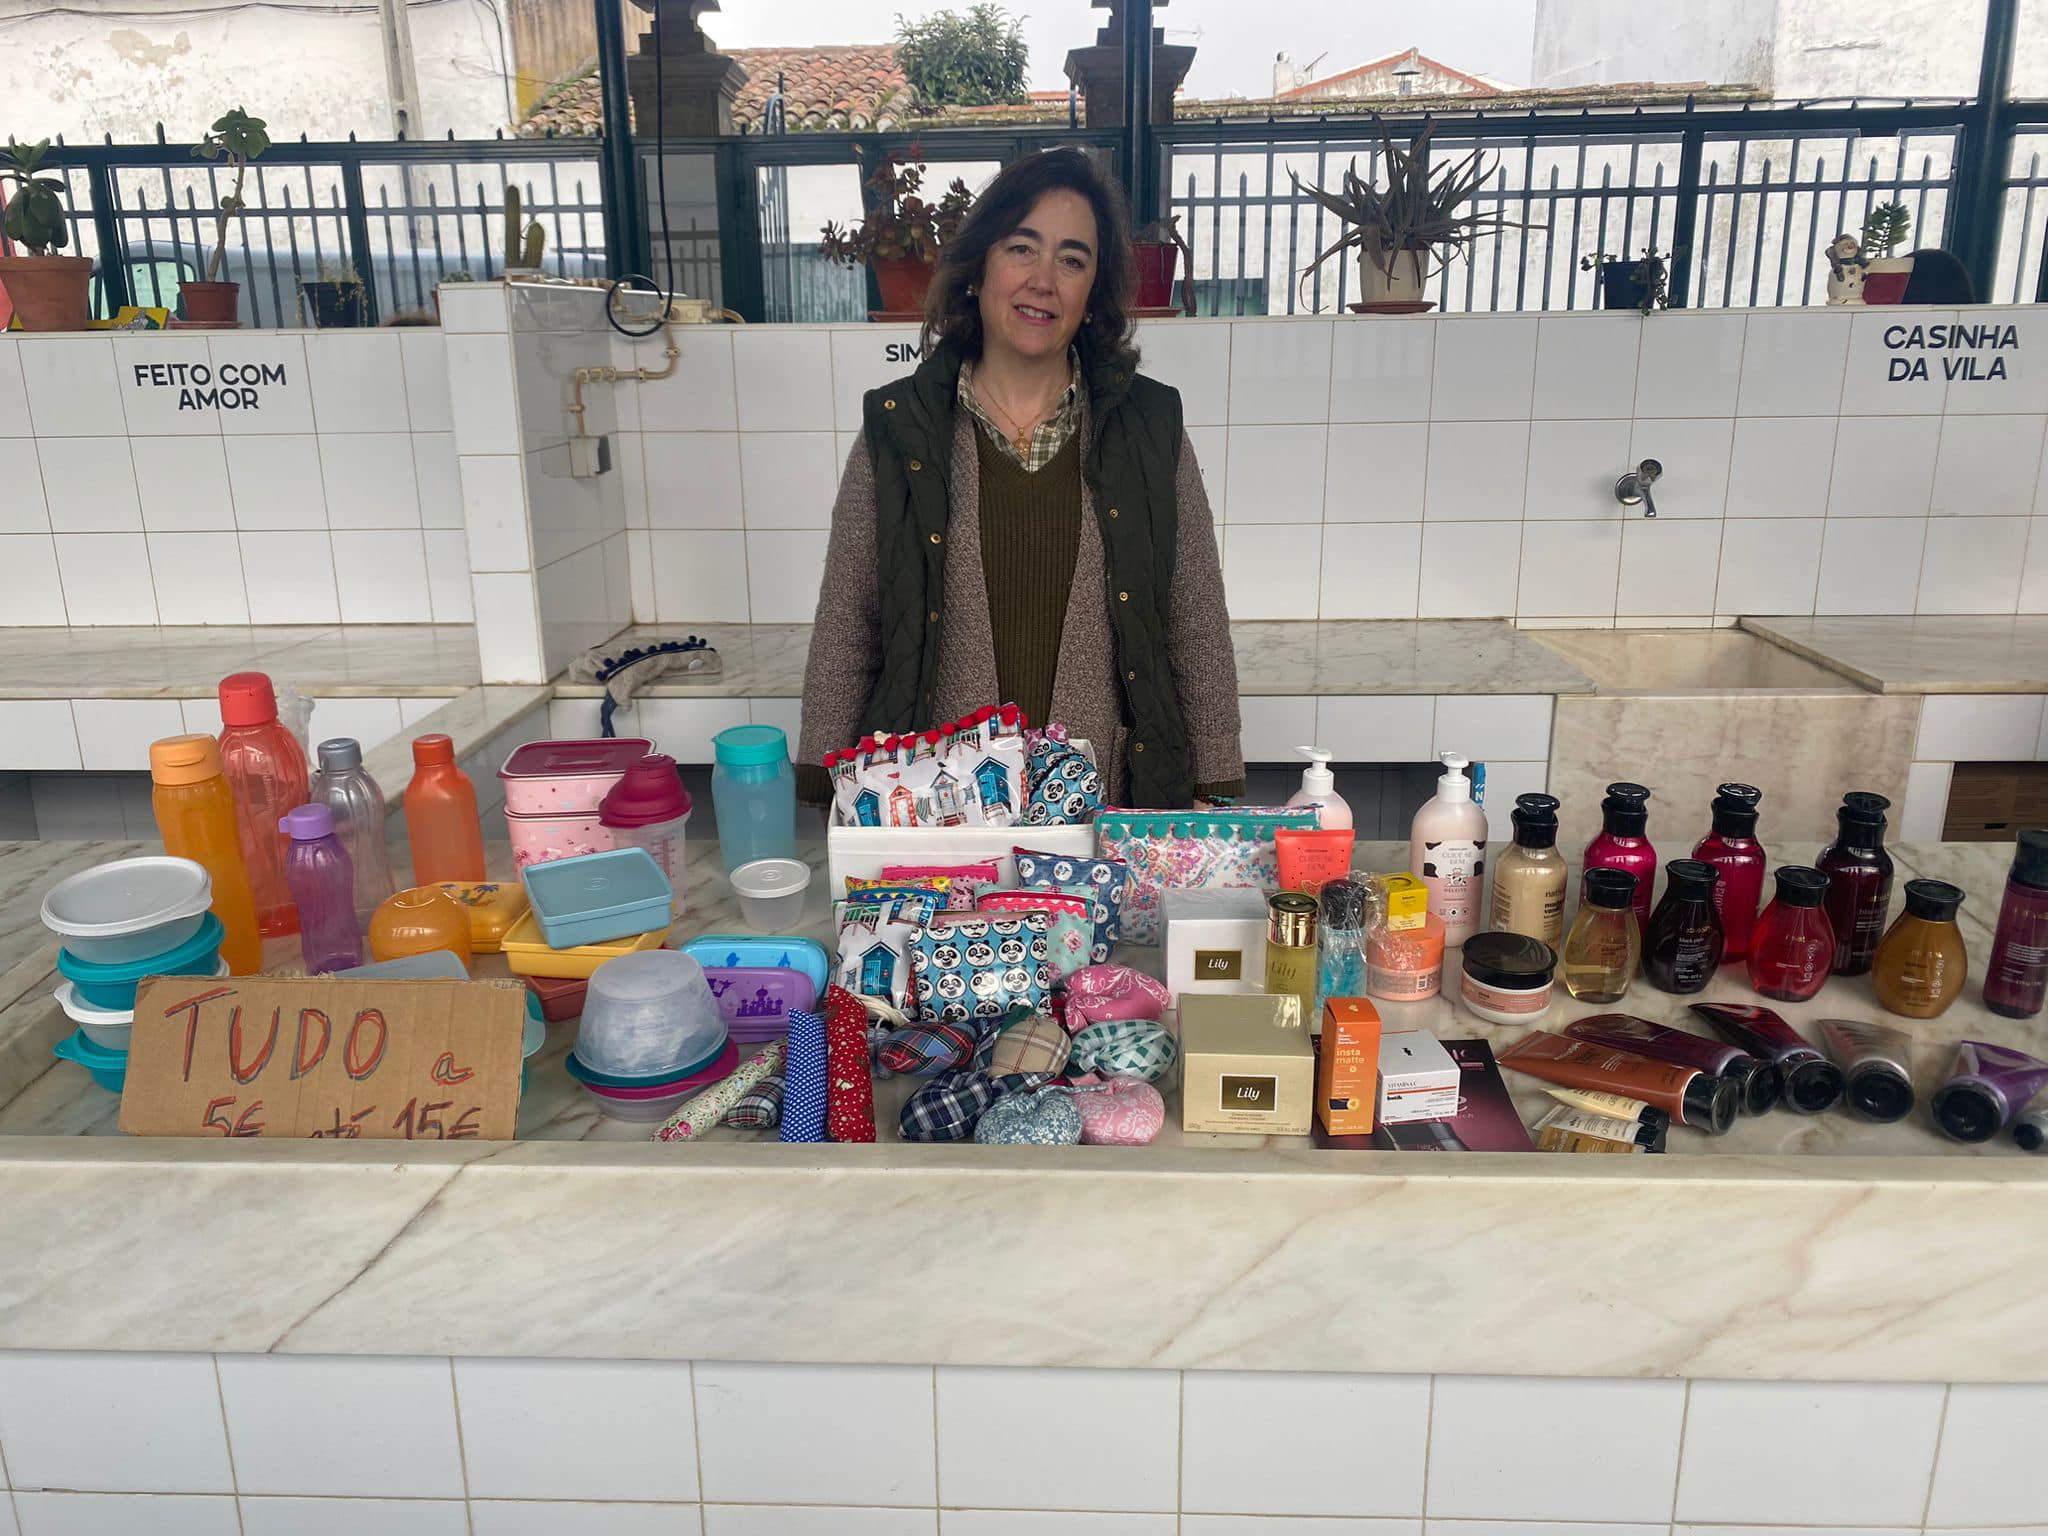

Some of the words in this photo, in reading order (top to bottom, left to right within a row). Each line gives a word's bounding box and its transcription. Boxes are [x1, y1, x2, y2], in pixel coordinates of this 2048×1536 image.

[1883, 324, 2019, 349] CASINHA
[134, 363, 211, 387] FEITO
[219, 363, 287, 386] COM
[1888, 357, 1929, 382] DA
[1943, 356, 2008, 381] VILA
[178, 387, 260, 410] AMOR
[1207, 958, 1229, 971] Lily
[1271, 961, 1297, 979] Lily
[164, 985, 390, 1085] TUDO
[1335, 1056, 1365, 1065] matte
[1336, 1048, 1361, 1056] insta
[1236, 1086, 1260, 1101] Lily
[202, 1095, 266, 1138] 5€
[393, 1097, 482, 1140] 15€
